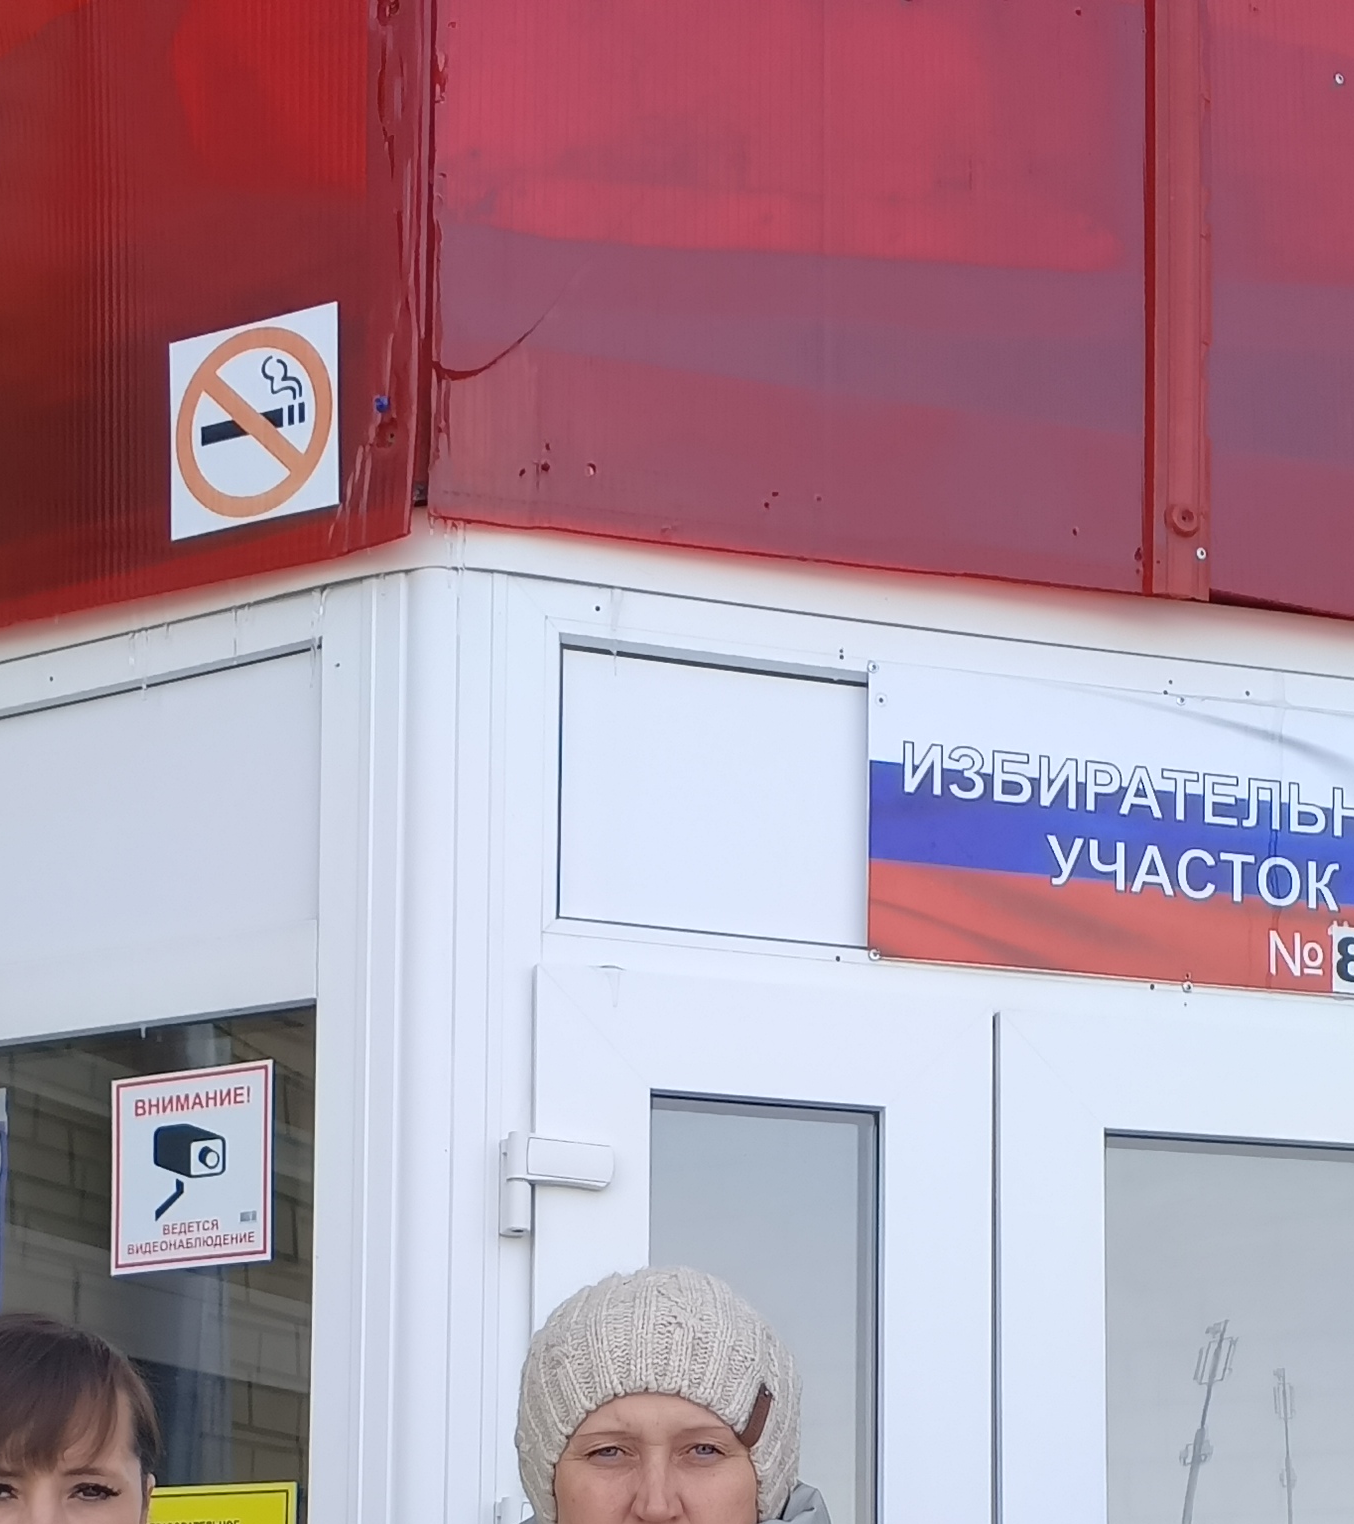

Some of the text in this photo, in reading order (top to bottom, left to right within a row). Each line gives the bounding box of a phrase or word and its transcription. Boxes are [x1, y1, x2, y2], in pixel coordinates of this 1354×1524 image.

[1046, 833, 1341, 912] УЧАСТОК
[134, 1085, 252, 1117] ВНИМАНИЕ!
[162, 1219, 220, 1237] ВЕДЕТСЯ
[127, 1231, 256, 1256] ВИДЕОНАБЛЮДЕНИЕ
